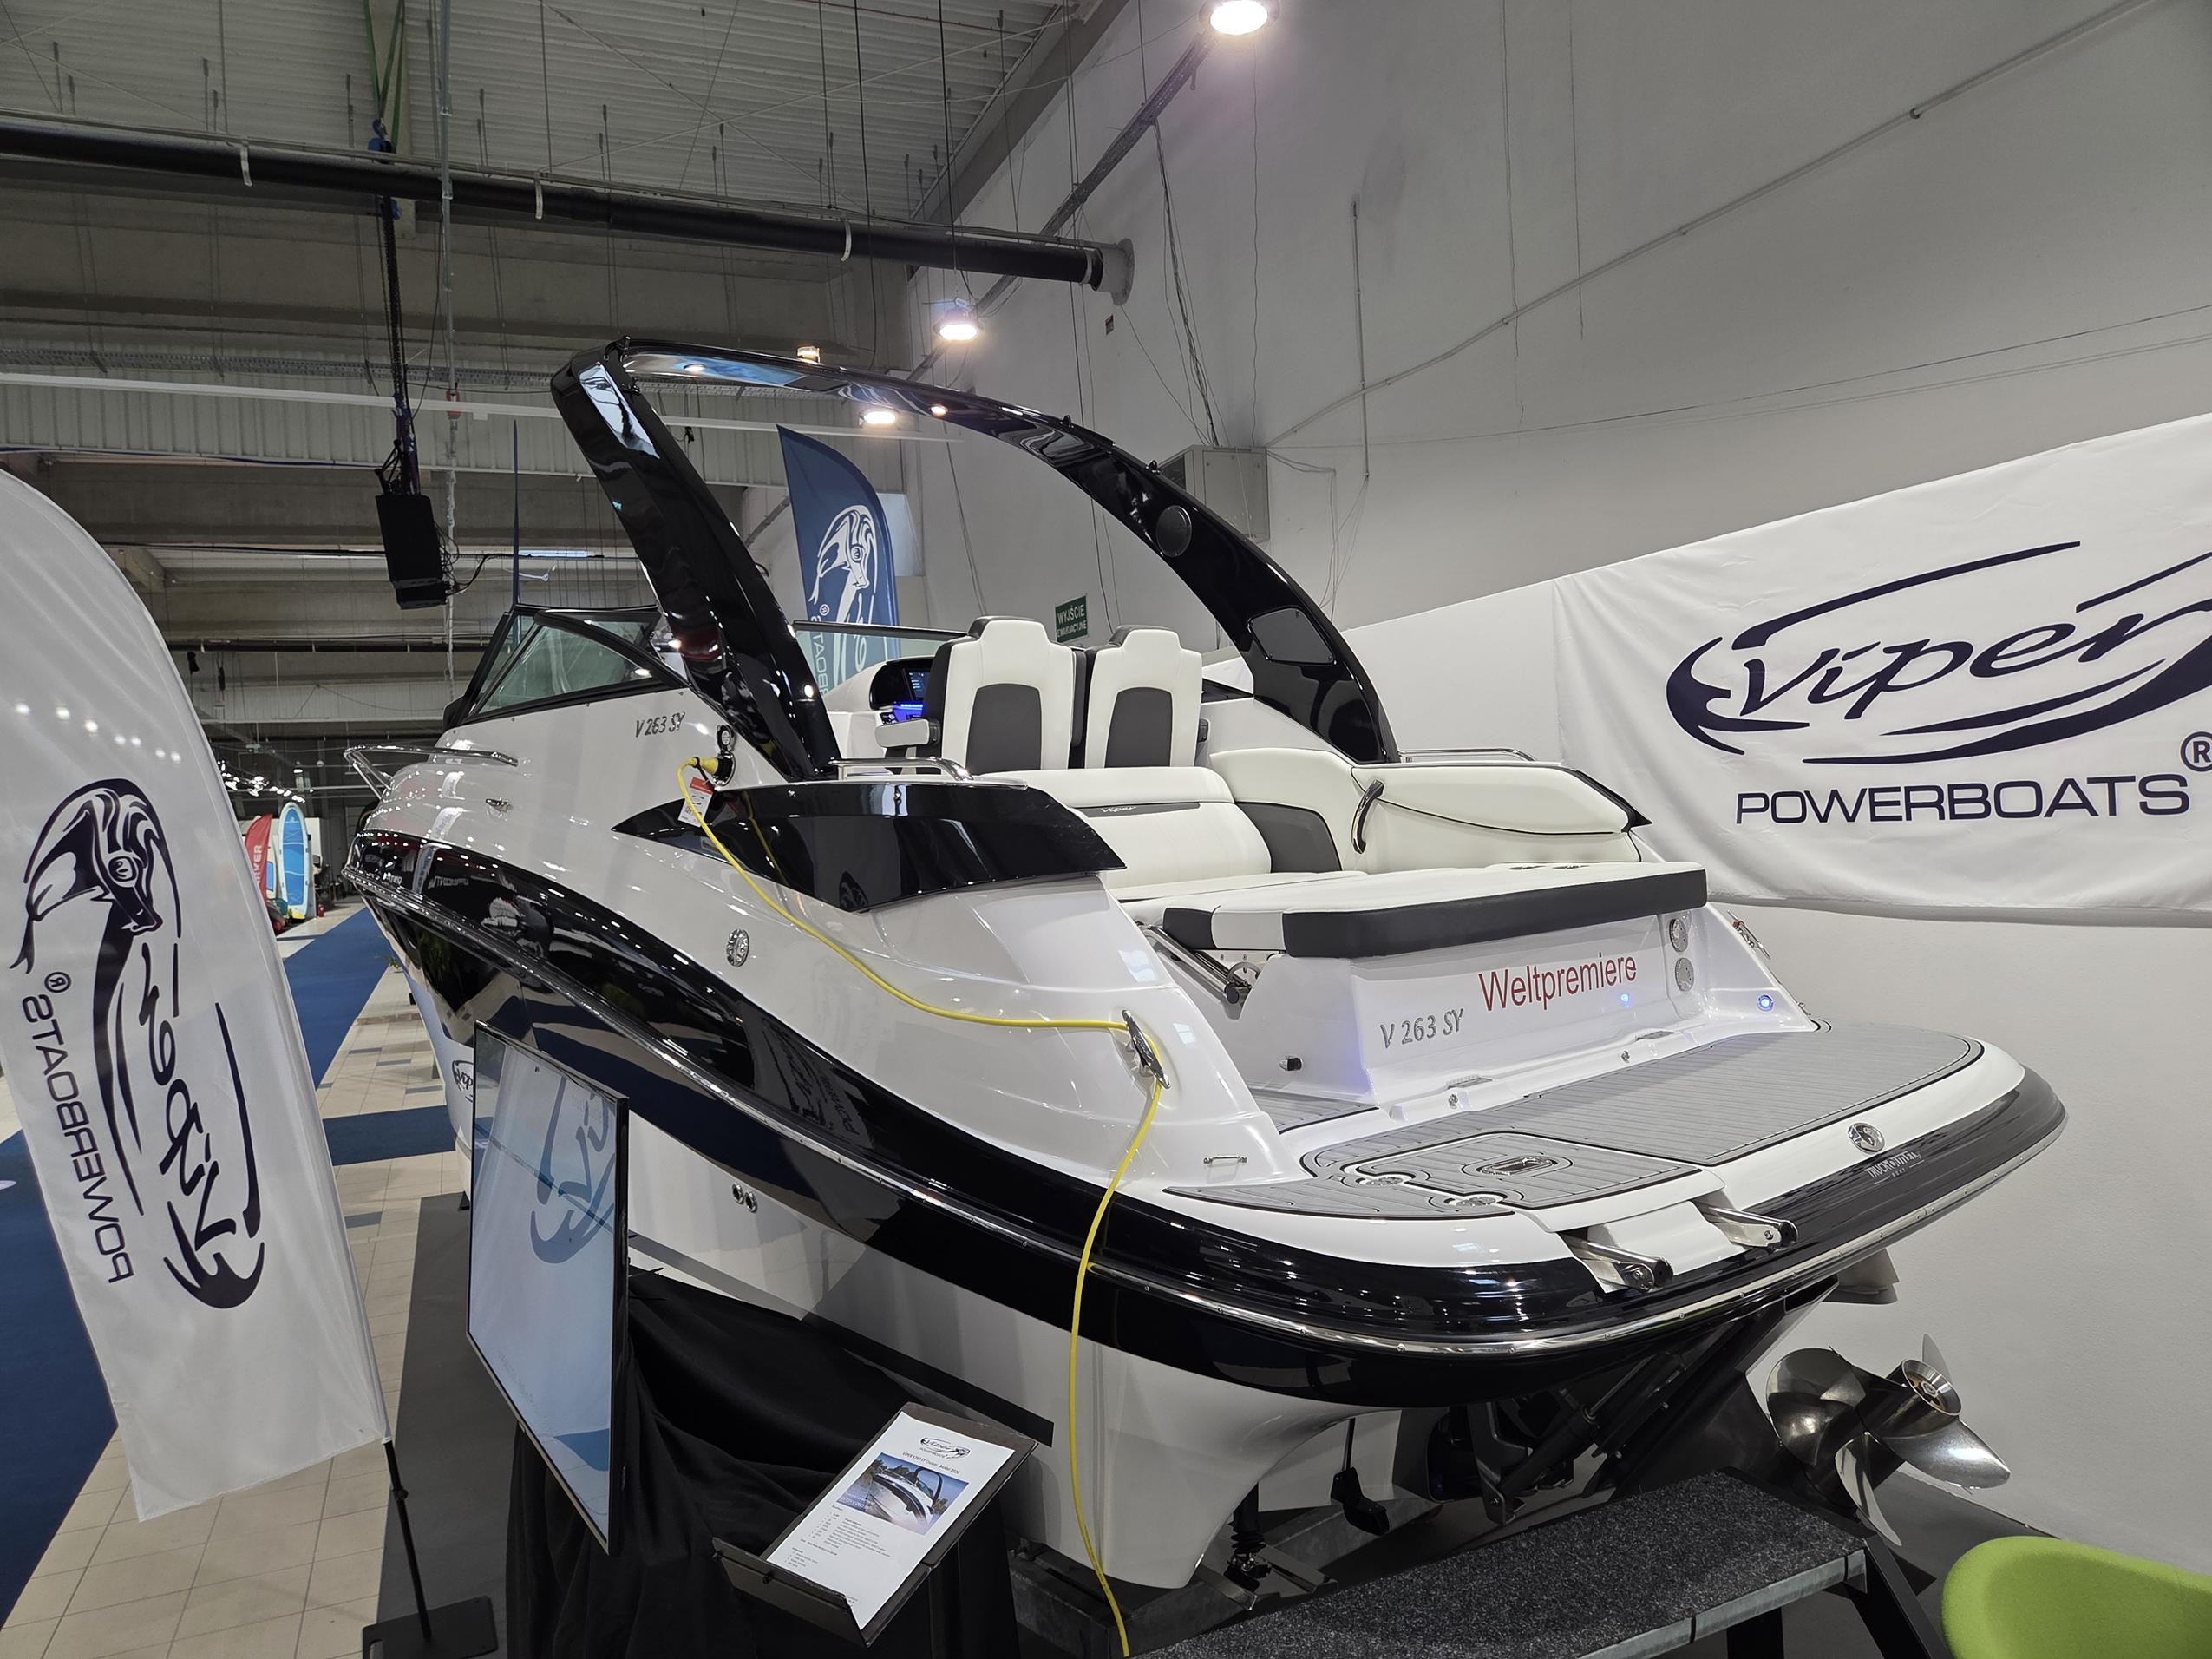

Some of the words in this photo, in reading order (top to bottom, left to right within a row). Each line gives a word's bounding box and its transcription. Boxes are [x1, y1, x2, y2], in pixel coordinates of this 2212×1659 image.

[1057, 605, 1084, 625] WYJŚCIE
[1739, 599, 2212, 720] Viper
[645, 715, 667, 736] 263
[669, 711, 686, 733] SY
[1100, 804, 1137, 814] Viper
[1736, 774, 2191, 825] POWERBOATS
[1477, 953, 1638, 1013] Weltpremiere
[1379, 1023, 1397, 1049] V
[1401, 1012, 1437, 1046] 263
[1441, 1007, 1465, 1037] SY
